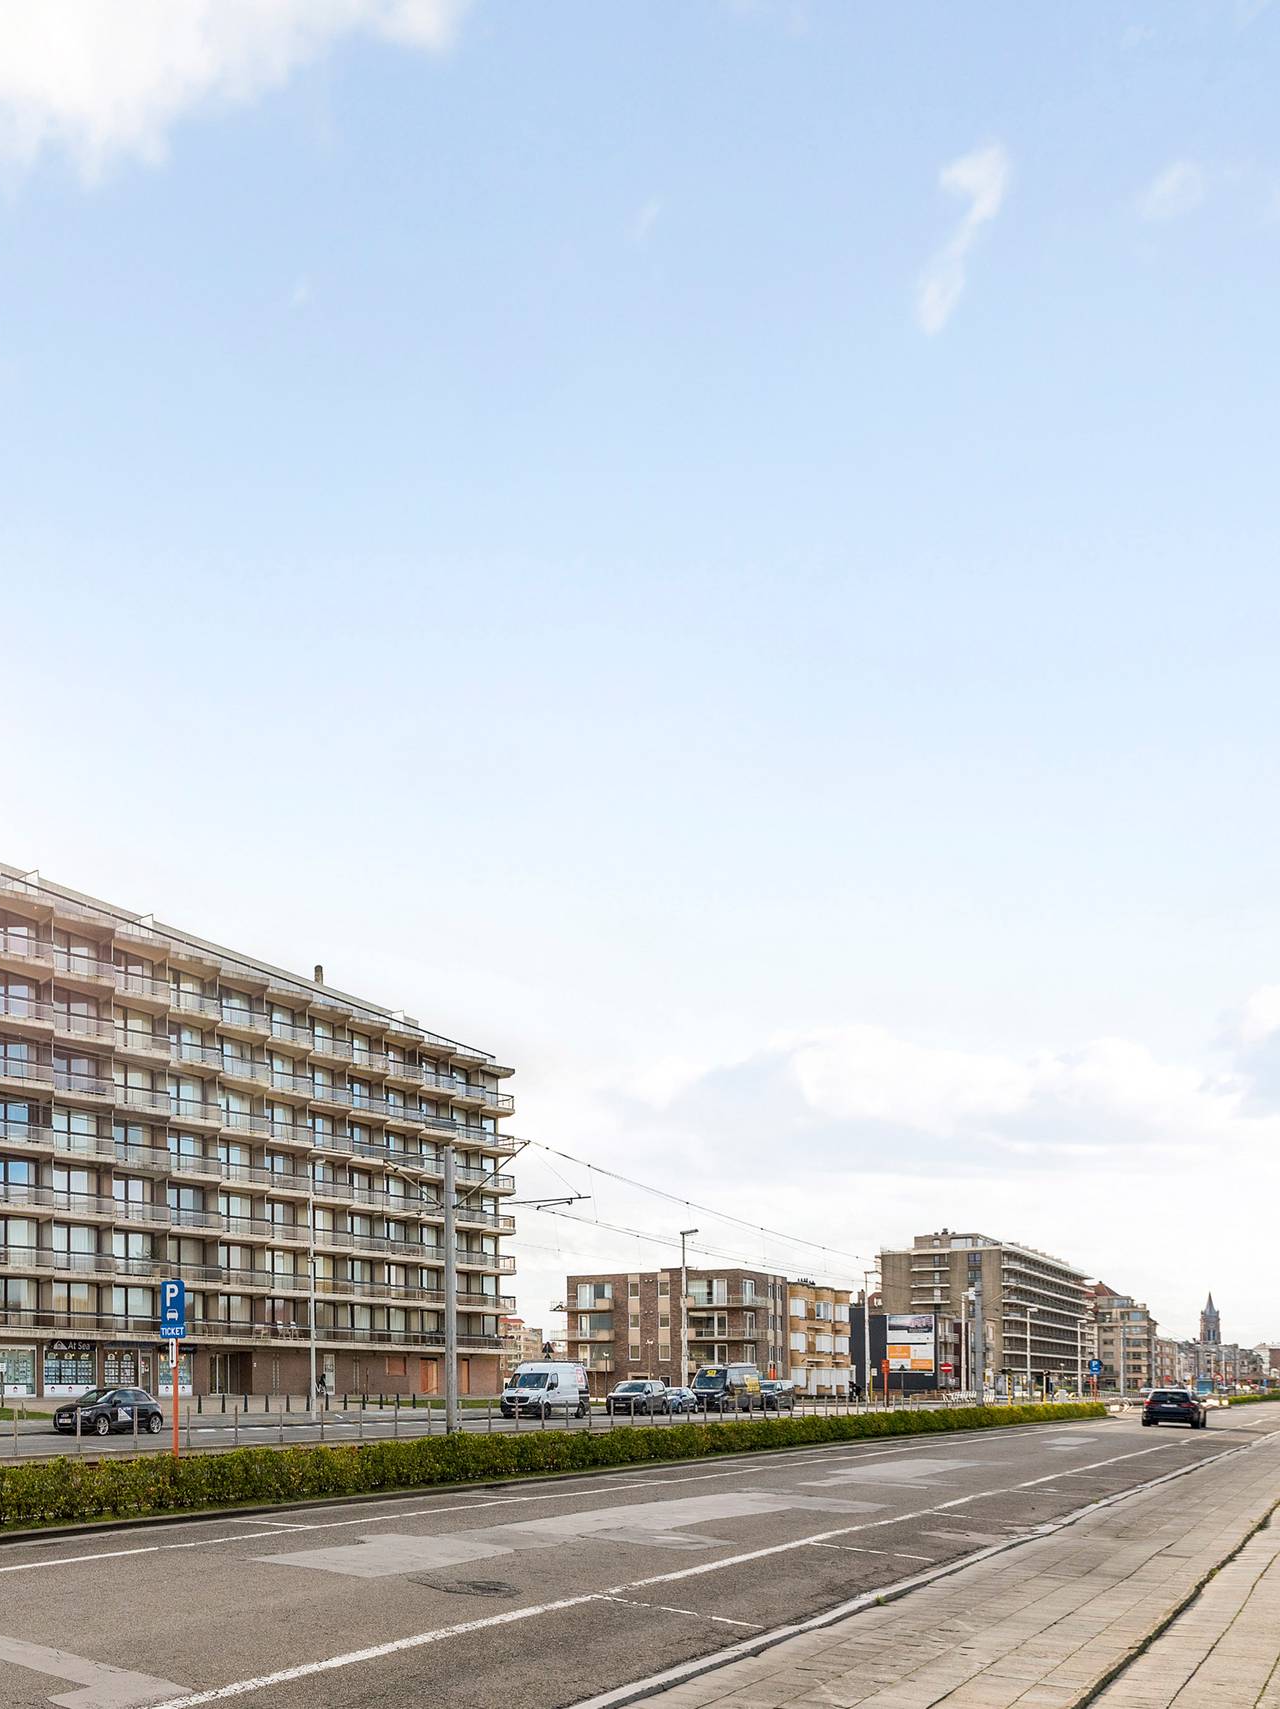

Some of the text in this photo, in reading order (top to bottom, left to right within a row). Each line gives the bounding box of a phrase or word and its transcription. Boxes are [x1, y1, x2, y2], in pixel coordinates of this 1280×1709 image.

[166, 1284, 179, 1306] P
[160, 1327, 184, 1336] TICKET
[67, 1341, 90, 1350] At Sea
